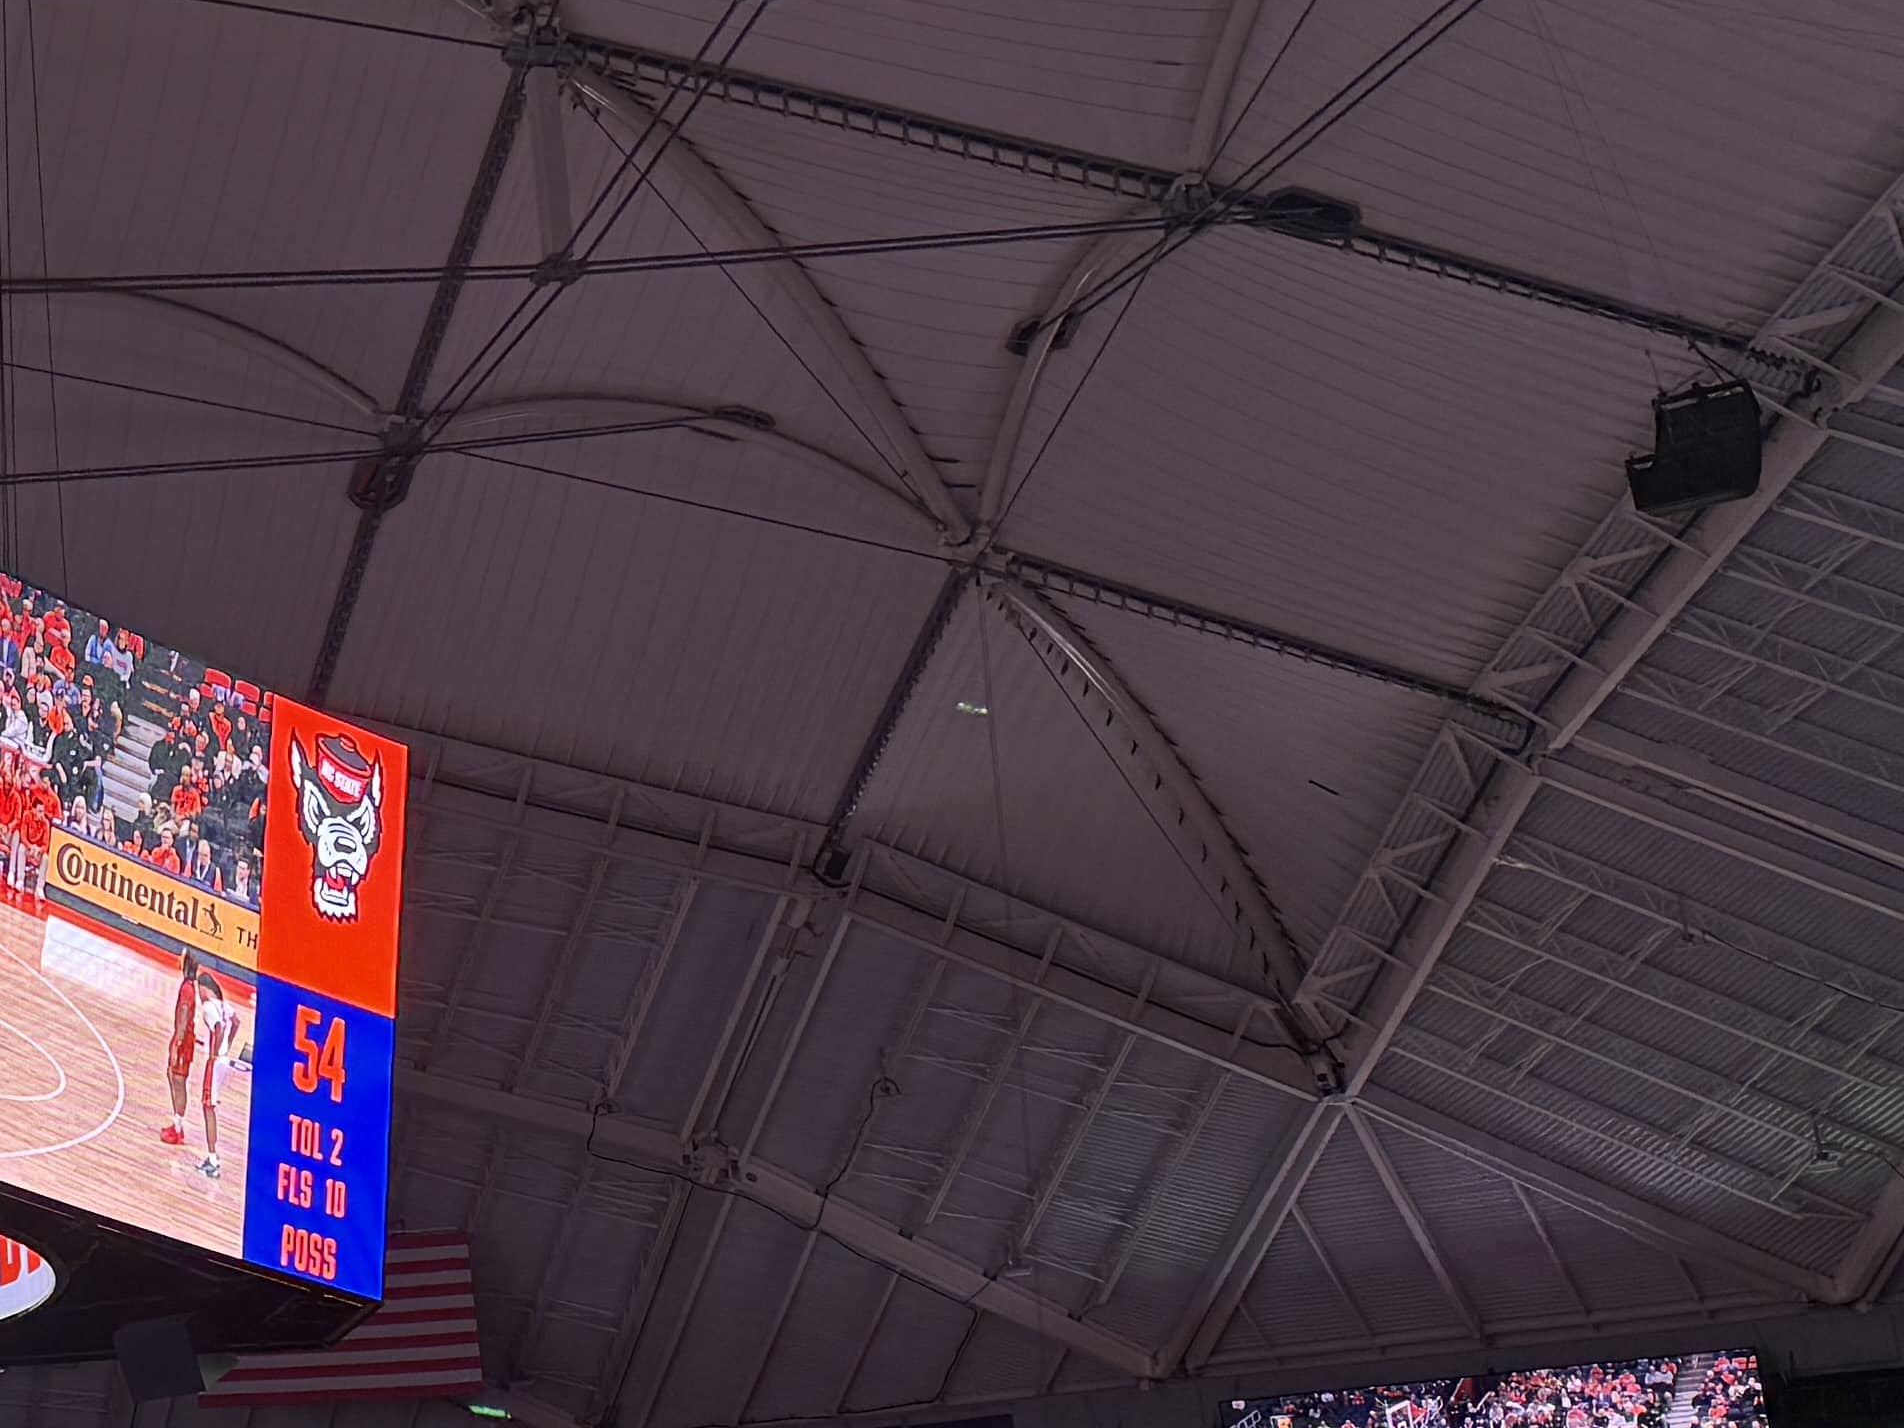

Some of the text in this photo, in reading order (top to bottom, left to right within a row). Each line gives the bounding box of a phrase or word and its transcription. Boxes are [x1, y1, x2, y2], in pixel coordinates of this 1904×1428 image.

[55, 842, 200, 932] Continental
[293, 1004, 347, 1103] 54
[290, 1114, 343, 1167] TOL 2
[277, 1164, 346, 1218] FLS 10
[280, 1222, 337, 1279] POSS
